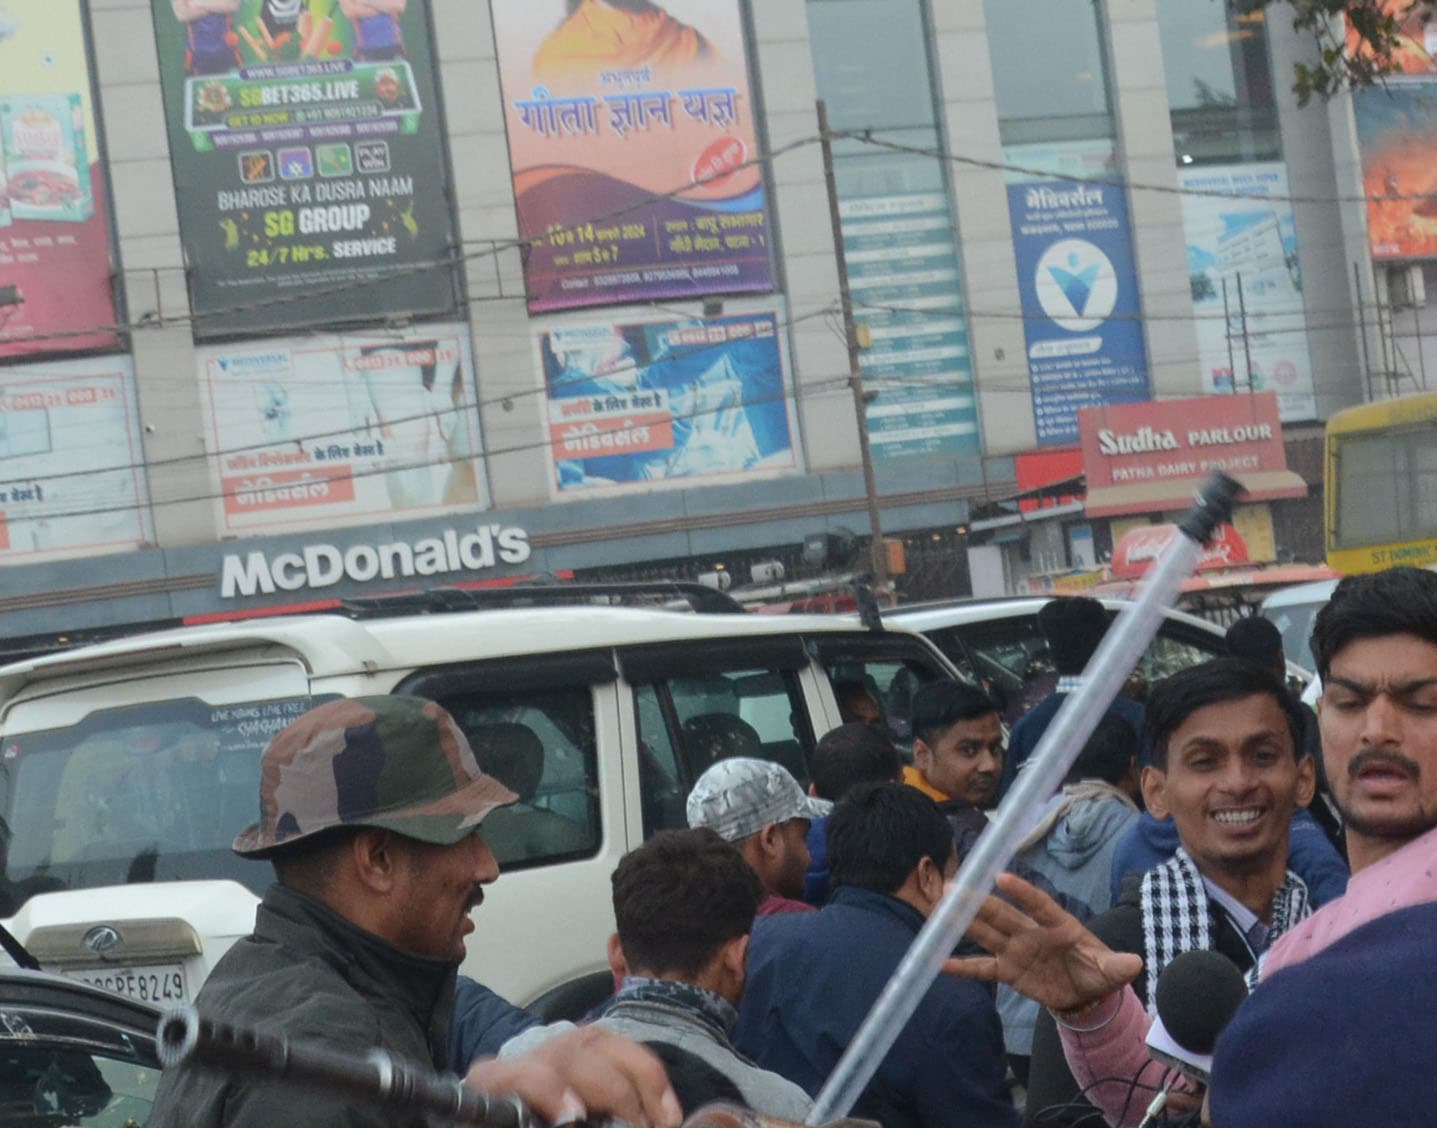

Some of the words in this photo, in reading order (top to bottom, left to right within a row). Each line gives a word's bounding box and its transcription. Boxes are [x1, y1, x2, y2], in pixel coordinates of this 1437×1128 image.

[514, 85, 597, 134] गीता
[603, 91, 672, 134] ज्ञान
[677, 87, 737, 127] यज्ञ
[217, 187, 288, 211] BHAROSE
[290, 185, 312, 204] KA
[315, 181, 366, 203] DUSRA
[368, 176, 414, 197] NAAM
[264, 210, 295, 237] SG
[299, 203, 371, 234] GROUP
[246, 247, 290, 267] 24/7
[332, 237, 397, 258] SERVICE
[1098, 426, 1179, 456] Sudha
[1187, 424, 1273, 447] PARLOUR
[1112, 466, 1153, 481] PATNA
[1158, 461, 1198, 476] DAIRY
[1201, 456, 1260, 472] PROJECT
[221, 523, 532, 598] McDonald's
